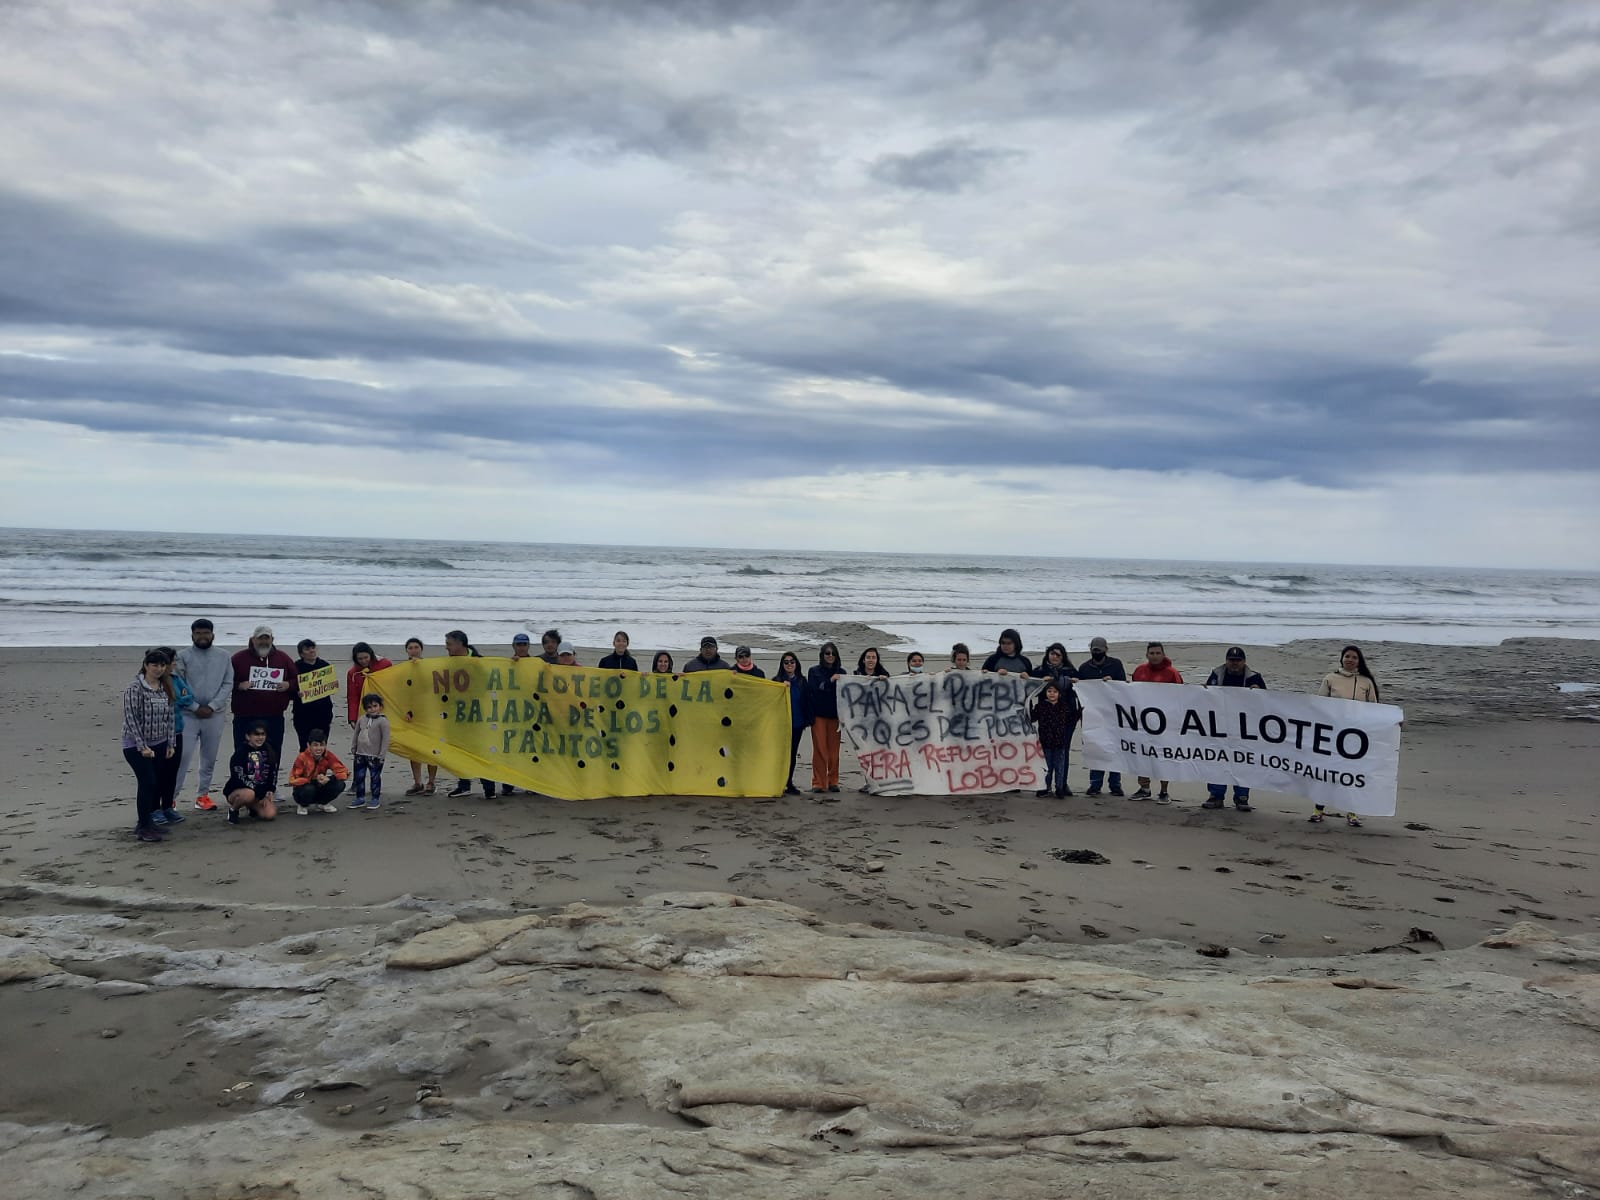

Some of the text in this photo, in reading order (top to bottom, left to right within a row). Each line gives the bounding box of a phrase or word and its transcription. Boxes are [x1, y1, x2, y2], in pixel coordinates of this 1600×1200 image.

[432, 668, 714, 703] NO AL LOTEO DE LA
[841, 676, 910, 718] PARA
[913, 681, 943, 714] EL
[455, 699, 660, 733] BAJADA DE LOS
[937, 714, 980, 741] DEL
[1115, 703, 1369, 760] NO AL LOTEO
[503, 729, 620, 758] PALITOS
[947, 765, 1036, 792] LOBOS
[1121, 739, 1366, 788] DE LA BAJADA DE LOS PALITOS
